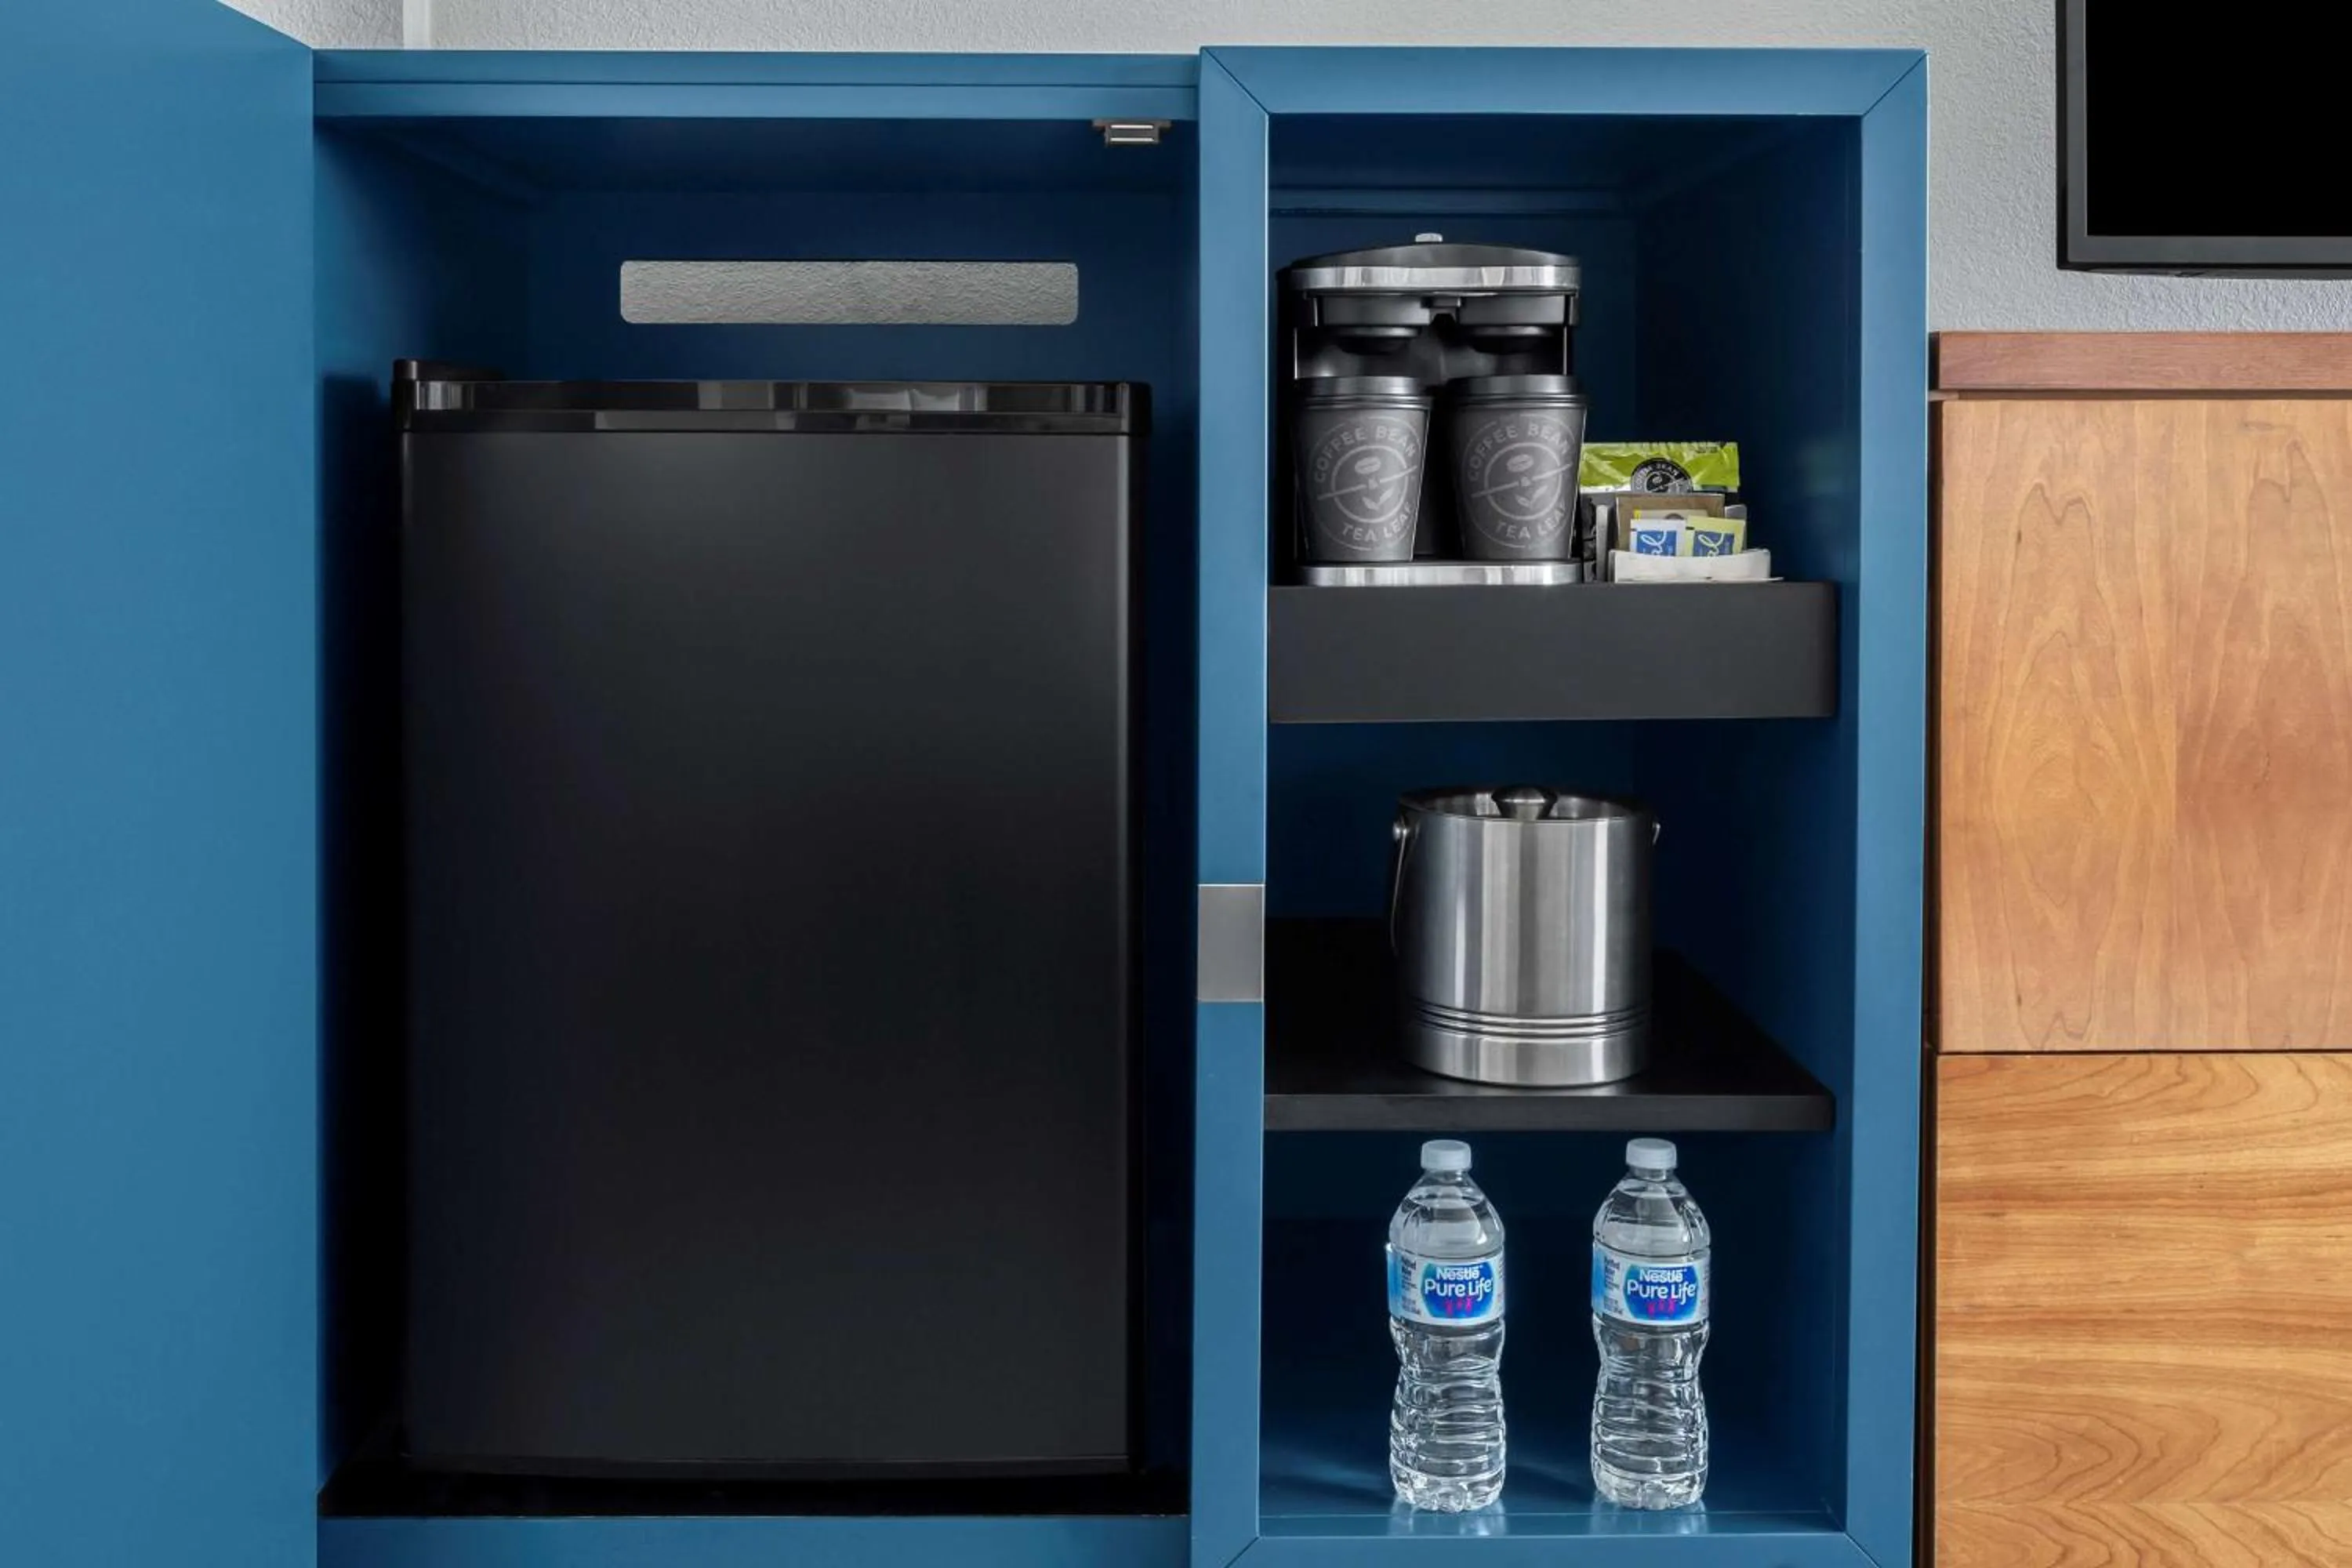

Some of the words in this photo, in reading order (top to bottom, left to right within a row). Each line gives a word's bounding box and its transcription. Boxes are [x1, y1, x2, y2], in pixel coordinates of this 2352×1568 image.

[1314, 426, 1366, 483] COFFEE
[1468, 424, 1518, 481] COFFEE
[1342, 521, 1378, 542] TEA
[1496, 520, 1531, 539] TEA
[1425, 1279, 1466, 1297] Pure
[1468, 1278, 1492, 1301] Life
[1627, 1279, 1668, 1299] Pure
[1671, 1281, 1697, 1305] Life
